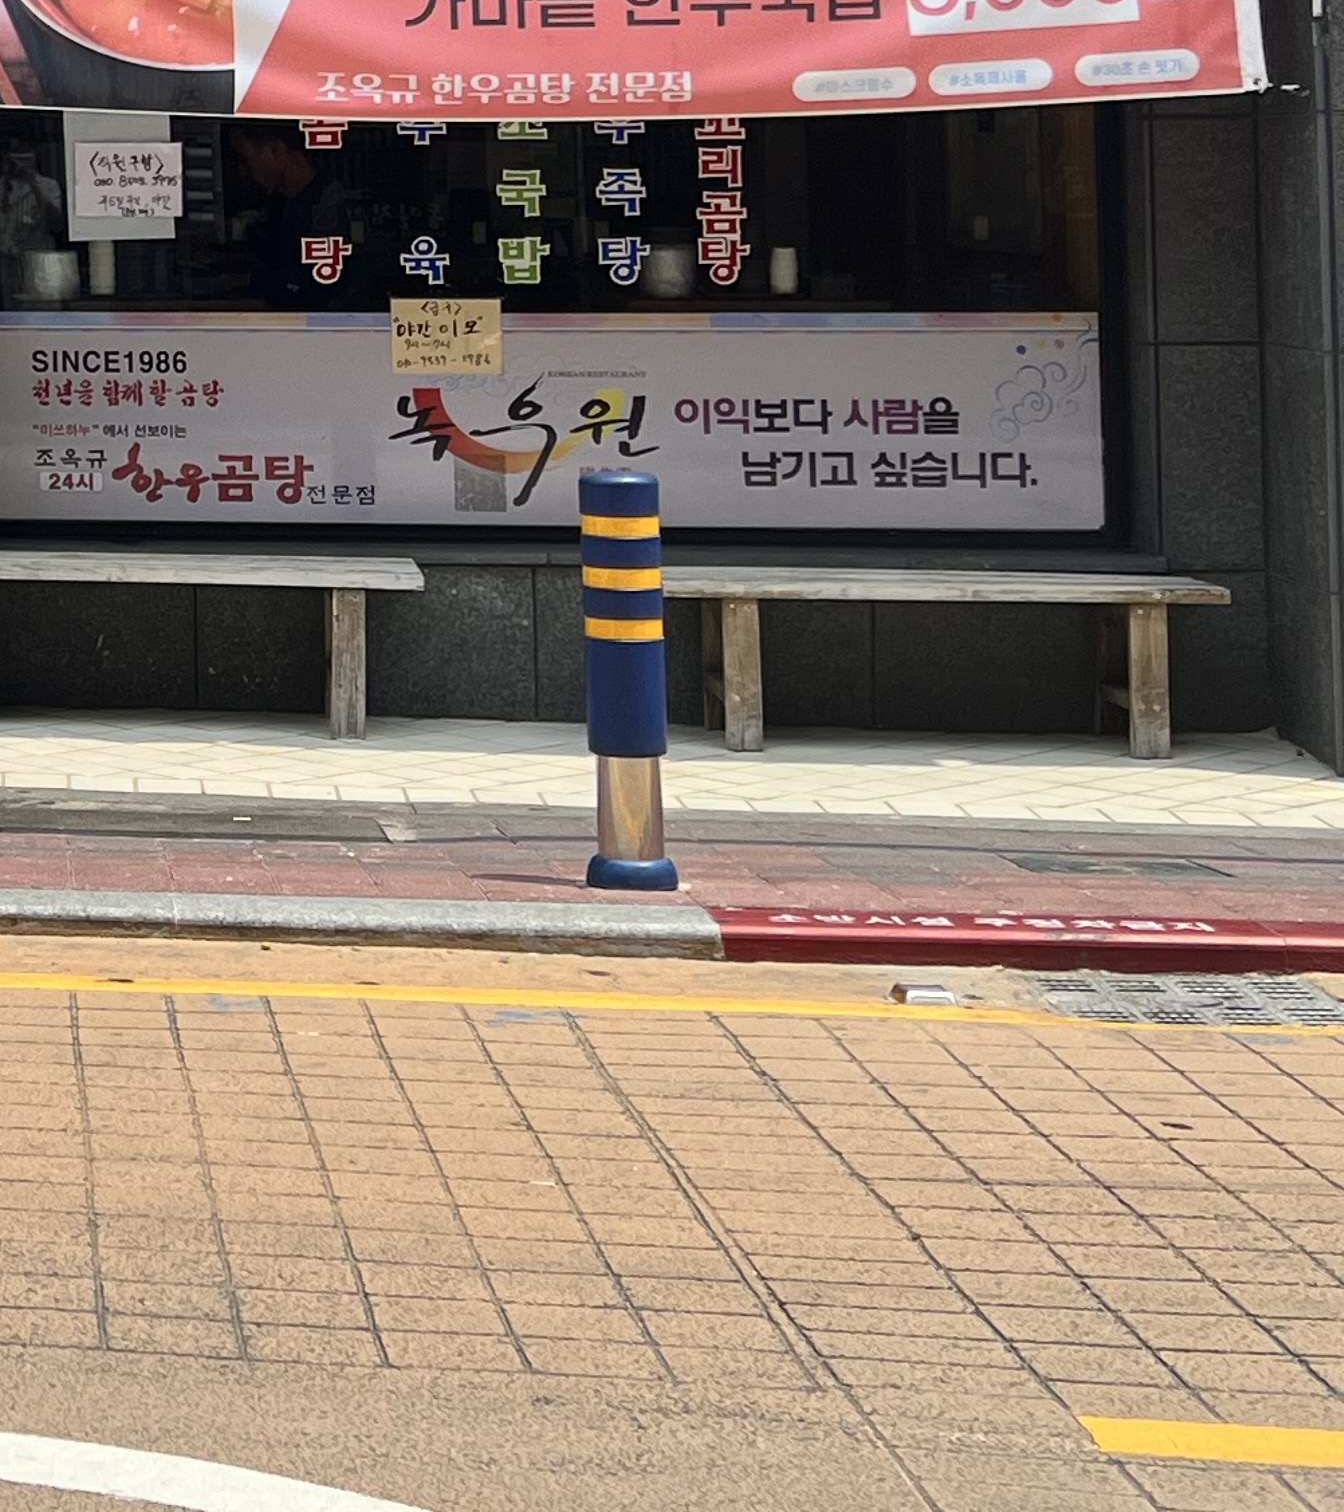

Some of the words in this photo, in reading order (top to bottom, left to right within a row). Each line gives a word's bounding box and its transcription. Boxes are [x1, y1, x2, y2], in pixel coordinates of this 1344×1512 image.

[313, 71, 419, 105] 조옥규
[430, 71, 576, 106] 한우곰탕
[584, 69, 694, 105] 전문점
[31, 349, 189, 374] SINCE1986
[31, 378, 96, 407] 천년을
[102, 378, 144, 407] 함께
[674, 395, 833, 438] 이익보다
[842, 394, 962, 438] 사람을
[134, 423, 188, 439] 선보이는
[387, 371, 661, 507] 녹우원
[33, 447, 109, 470] 조옥규
[111, 440, 316, 505] 한우곰탕
[740, 449, 859, 490] 남기고
[869, 448, 1040, 491] 싶습니다.
[47, 472, 95, 491] 24시
[305, 483, 377, 506] 전문점
